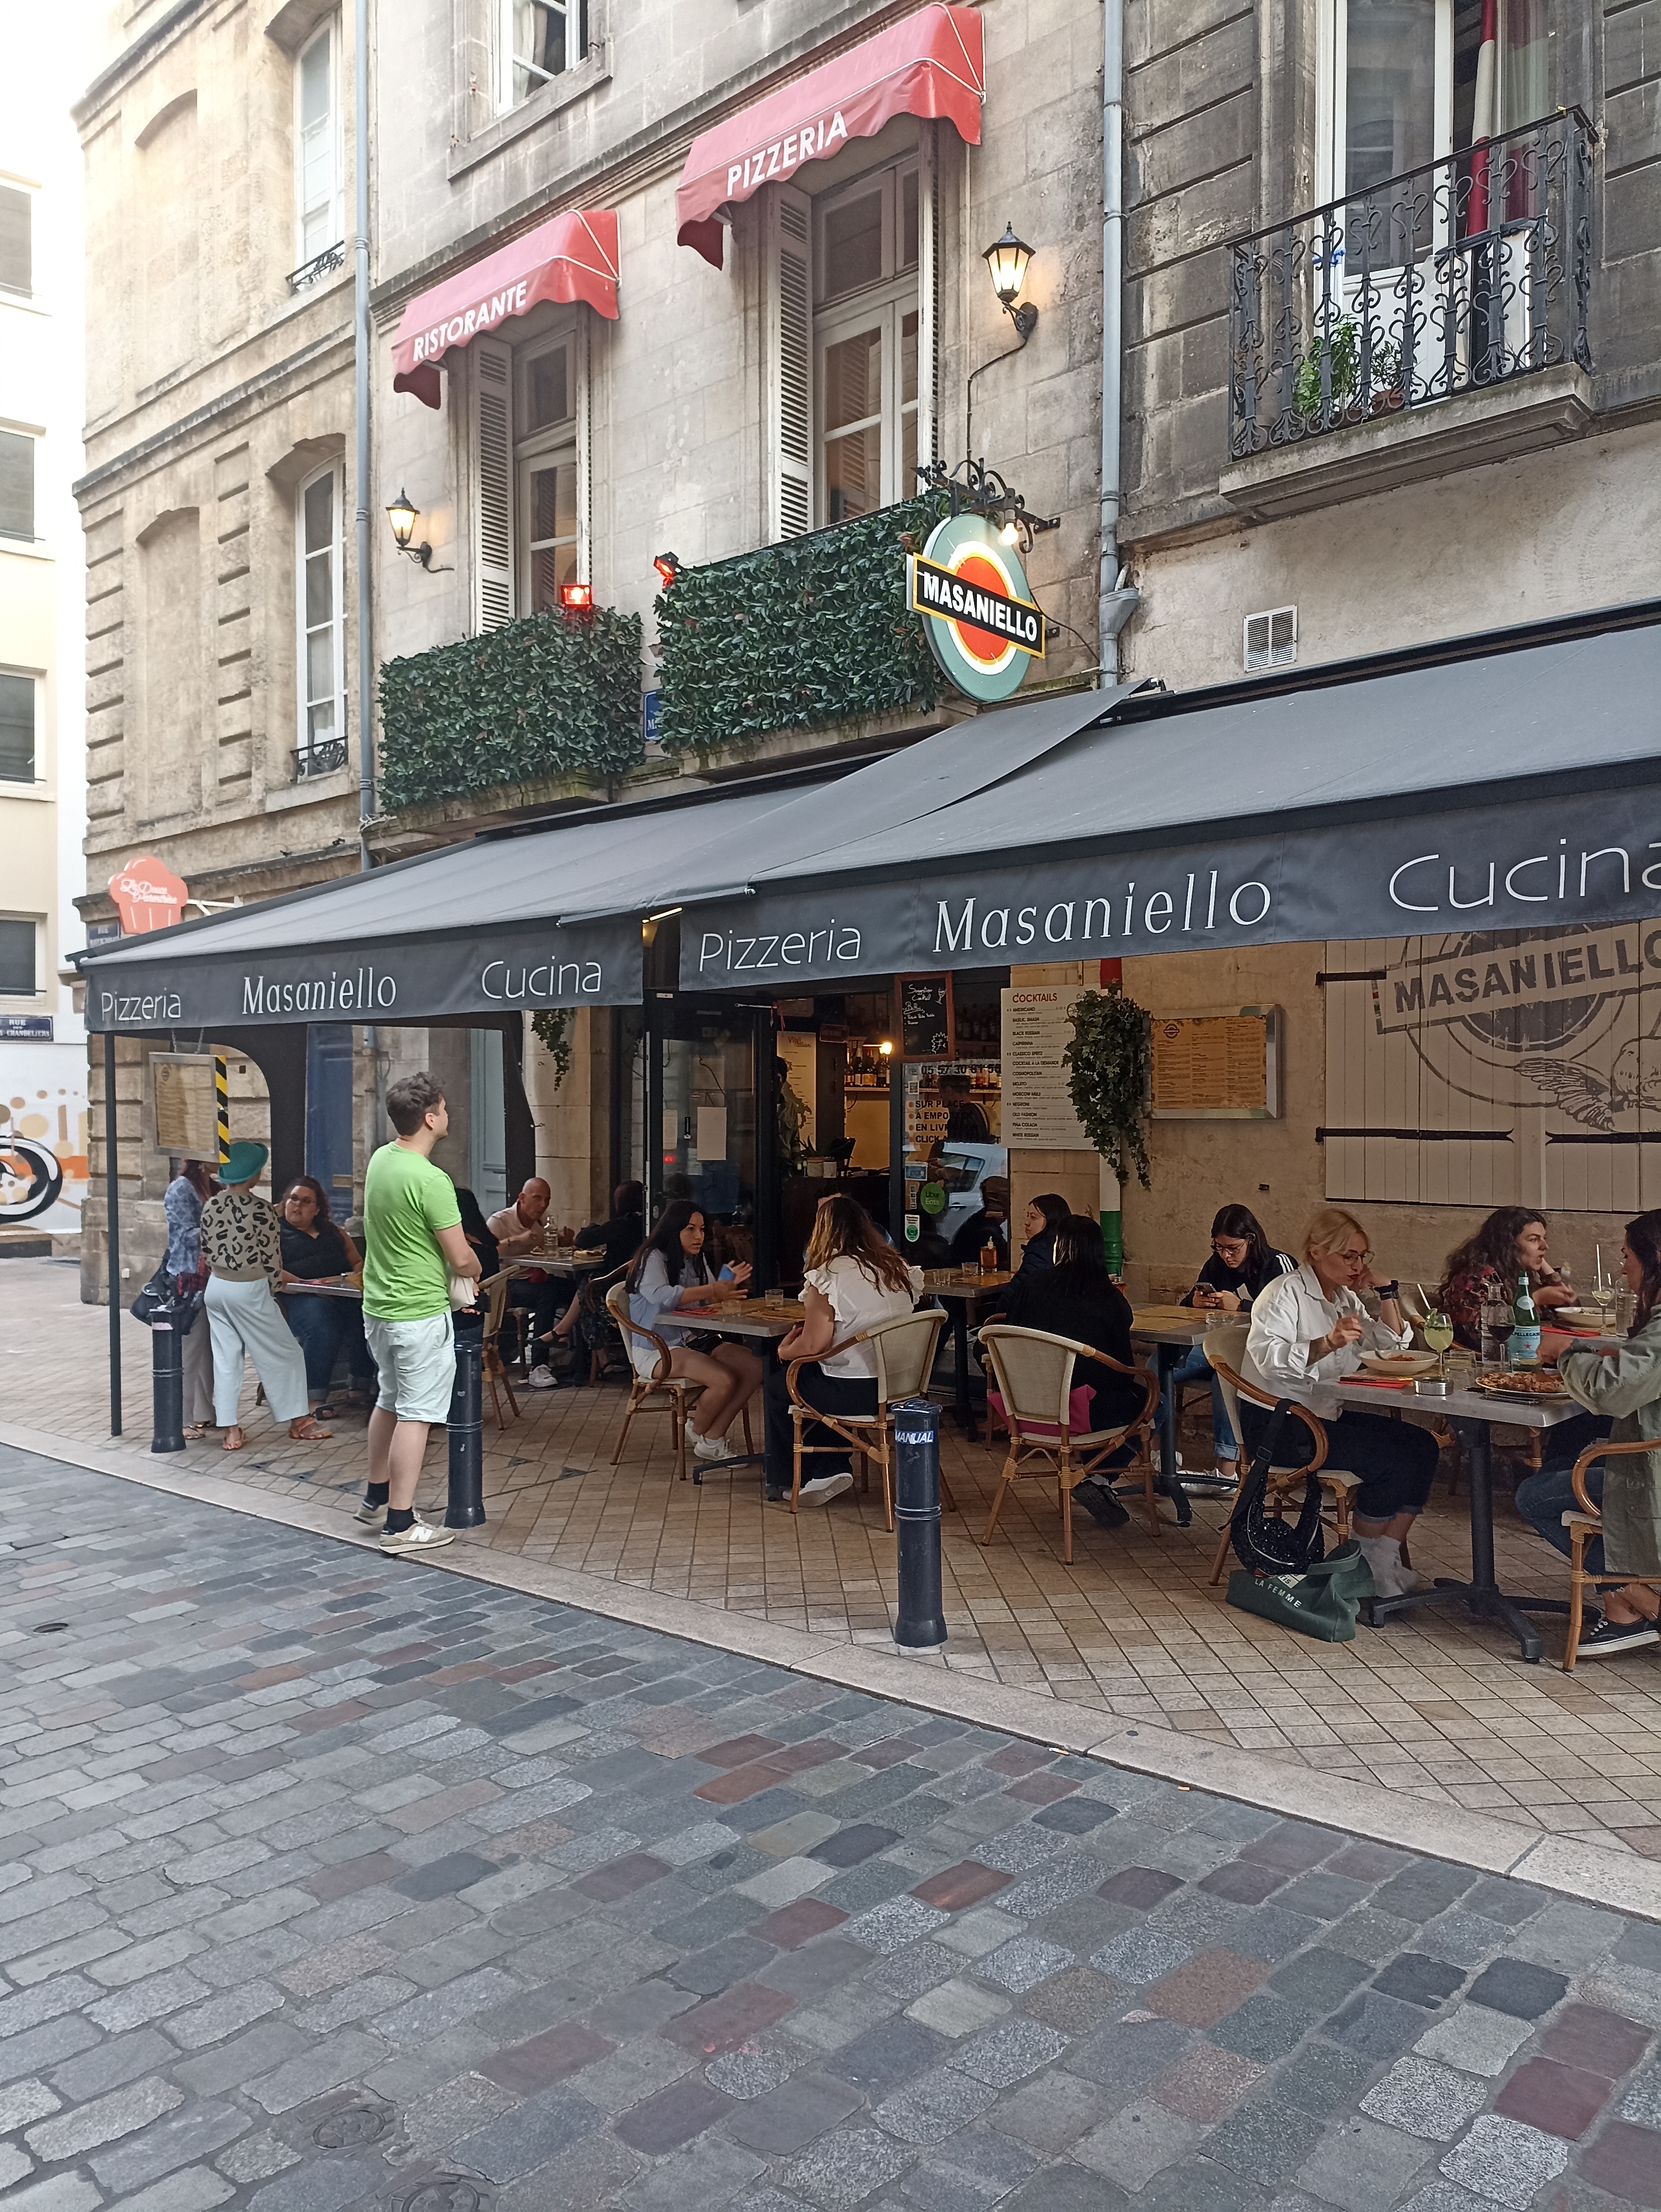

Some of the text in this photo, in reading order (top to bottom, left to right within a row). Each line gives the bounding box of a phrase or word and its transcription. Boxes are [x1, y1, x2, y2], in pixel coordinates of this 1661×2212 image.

[727, 111, 848, 196] PIZZERIA
[413, 280, 527, 361] RISTORANTE
[923, 572, 1037, 641] MASANIELLO
[699, 918, 861, 972] Pizzeria
[932, 870, 1272, 953] Masaniello
[101, 956, 601, 1021] Pizzeria Masaniello Cucina
[1012, 993, 1057, 1003] COCKTAILS
[921, 1065, 934, 1074] 05
[938, 1064, 952, 1074] 57
[1255, 1578, 1302, 1608] LA FEMME
